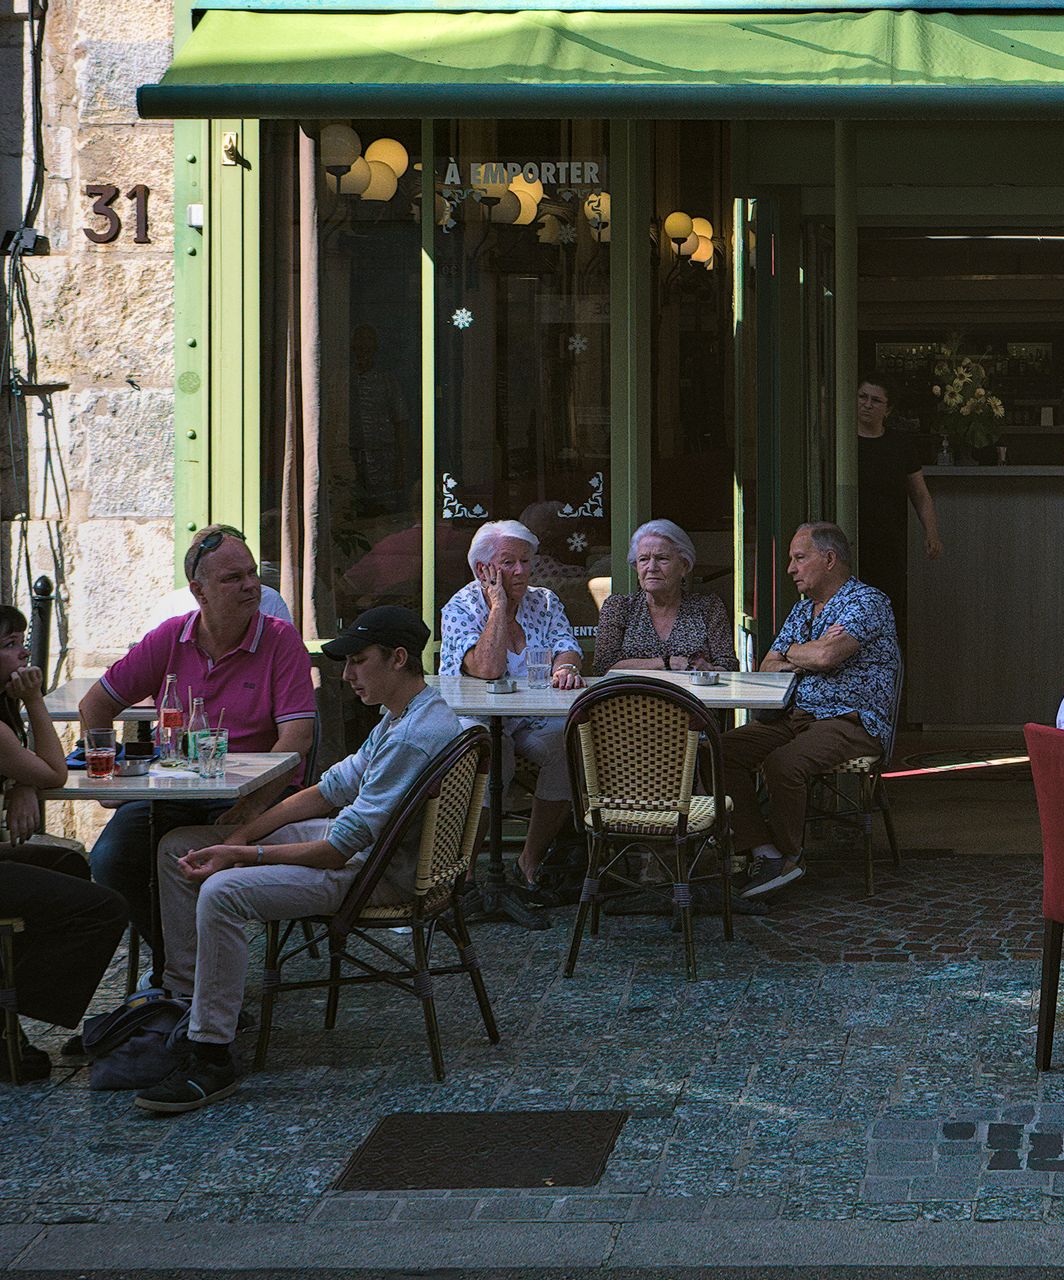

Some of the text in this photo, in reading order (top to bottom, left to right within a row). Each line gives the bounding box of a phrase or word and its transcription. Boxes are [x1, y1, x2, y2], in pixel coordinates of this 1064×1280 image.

[445, 158, 600, 184] À EMPORTER
[83, 184, 152, 244] 31
